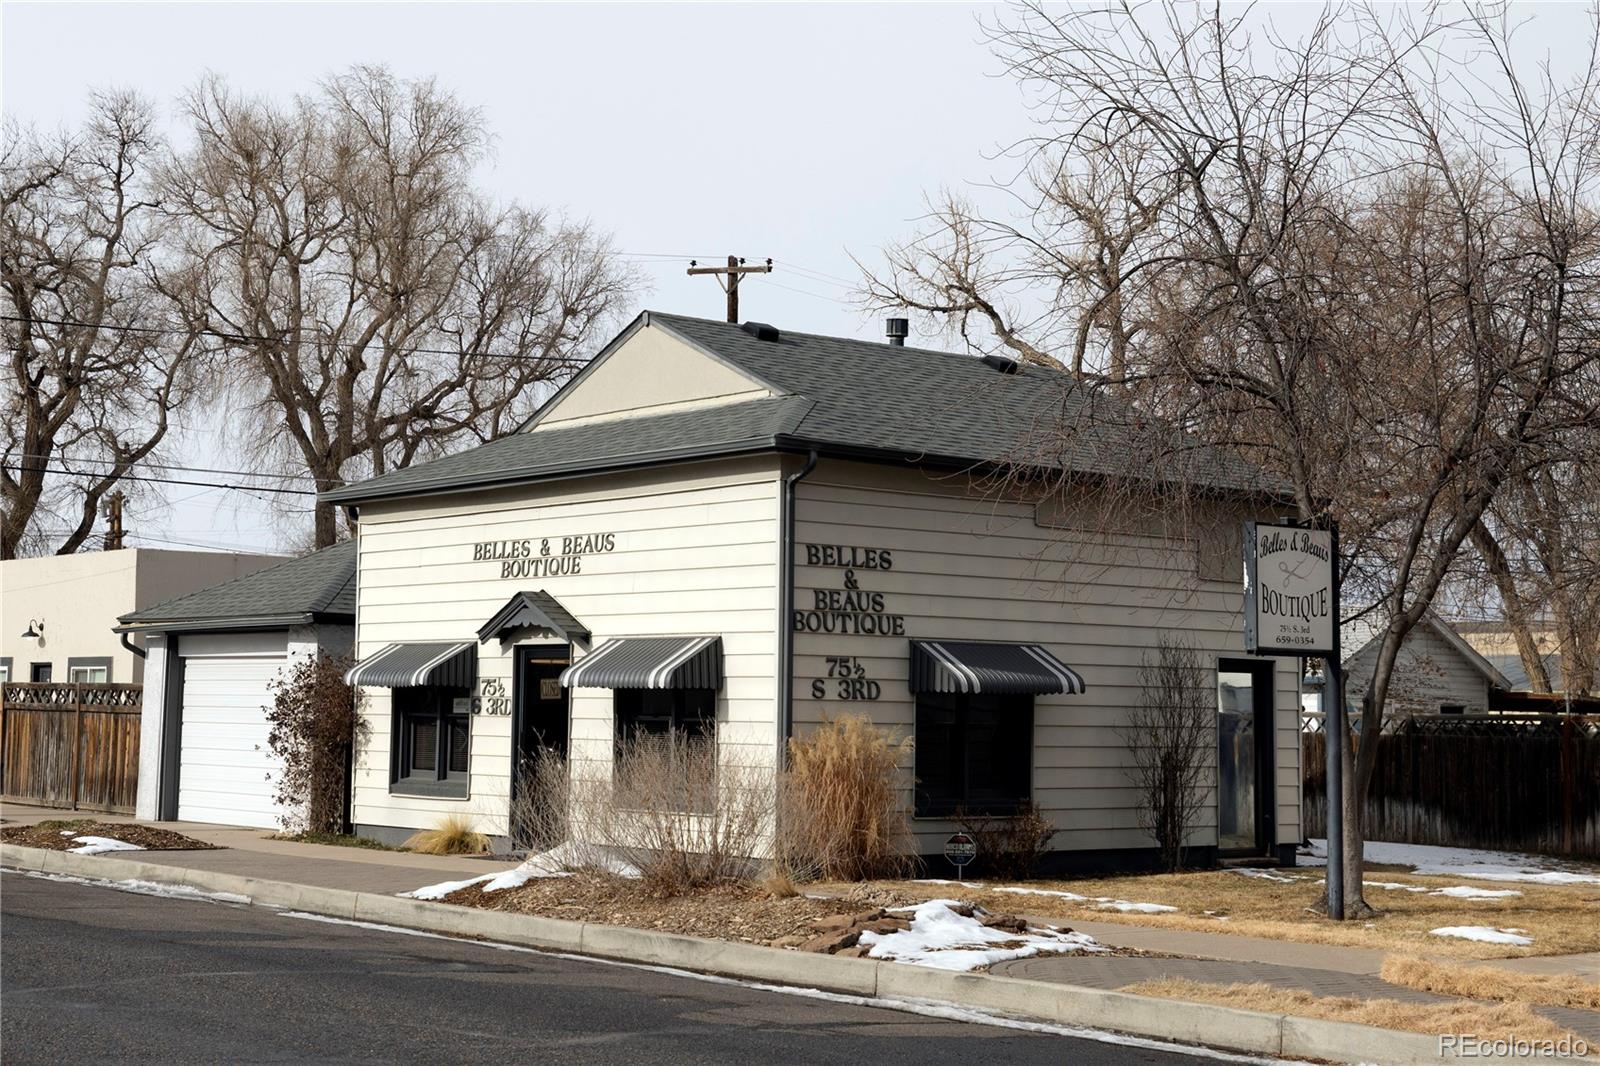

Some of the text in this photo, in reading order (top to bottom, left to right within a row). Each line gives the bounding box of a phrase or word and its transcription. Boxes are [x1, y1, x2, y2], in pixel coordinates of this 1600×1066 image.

[473, 533, 615, 561] BELLES & BEAUS
[806, 544, 892, 570] BELLES
[1260, 531, 1288, 558] Belles
[1300, 532, 1329, 562] Beaus
[500, 556, 581, 579] BOUTIQUE
[844, 569, 859, 590] &
[813, 589, 885, 613] BEAUS
[1261, 582, 1328, 622] BOUTIQUE
[793, 611, 905, 636] BOUTIQUE
[812, 679, 881, 701] S 3RD
[486, 697, 511, 716] 3RD
